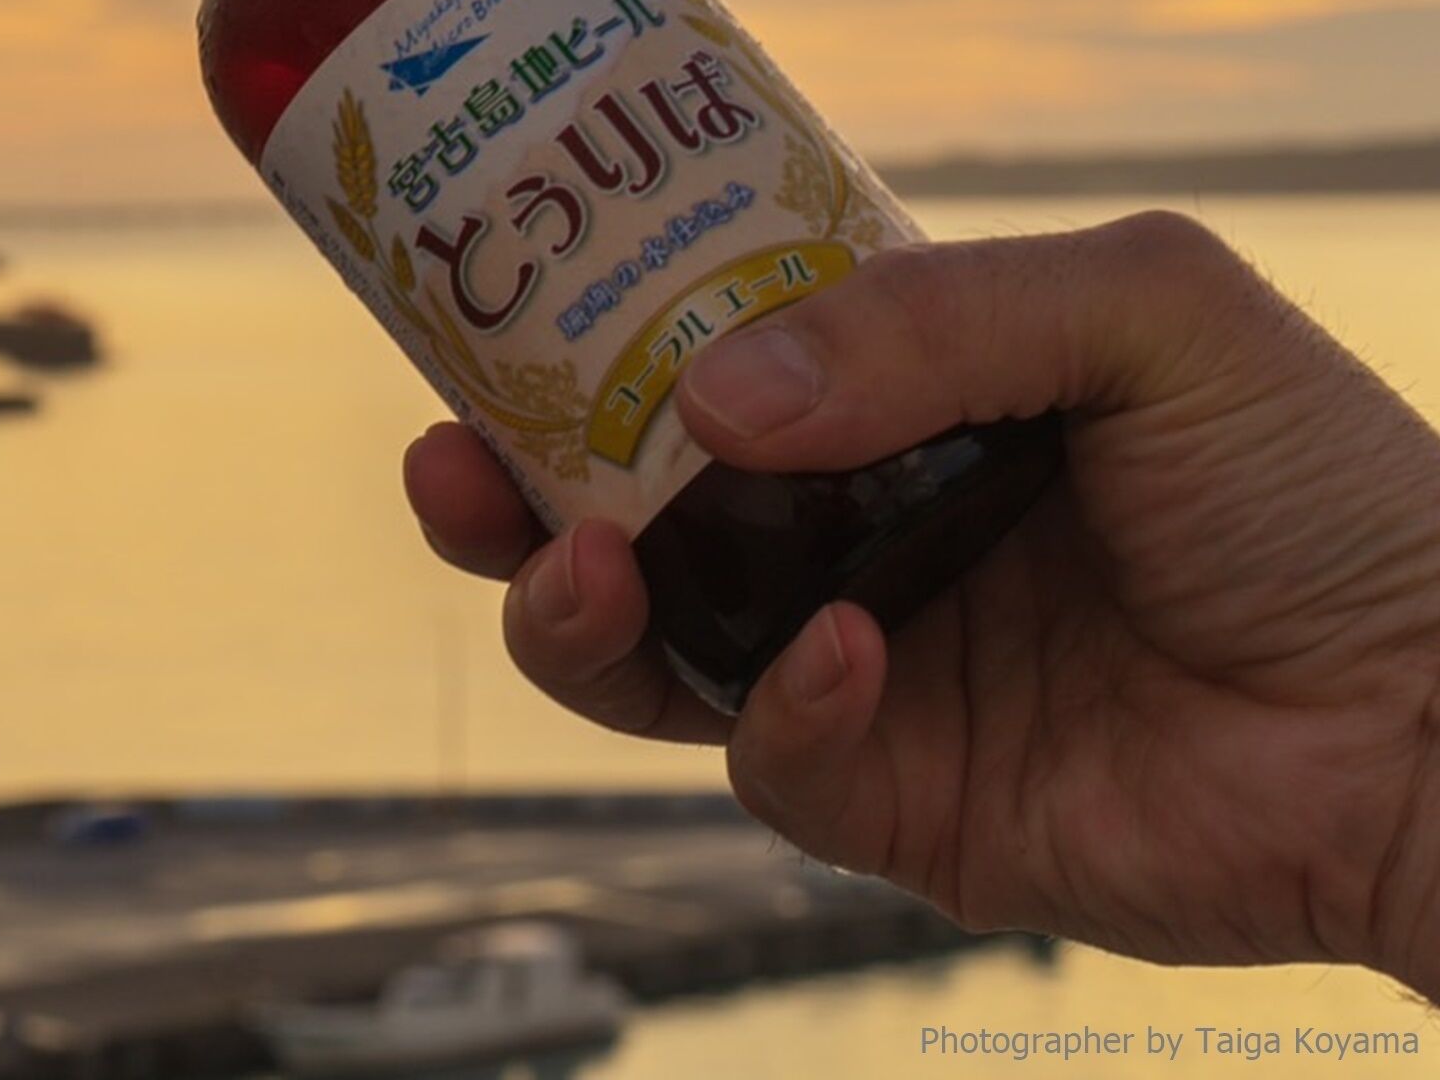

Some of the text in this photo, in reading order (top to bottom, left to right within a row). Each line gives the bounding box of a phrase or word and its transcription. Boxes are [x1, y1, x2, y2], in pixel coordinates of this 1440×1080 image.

[607, 252, 817, 426] コーラル エール
